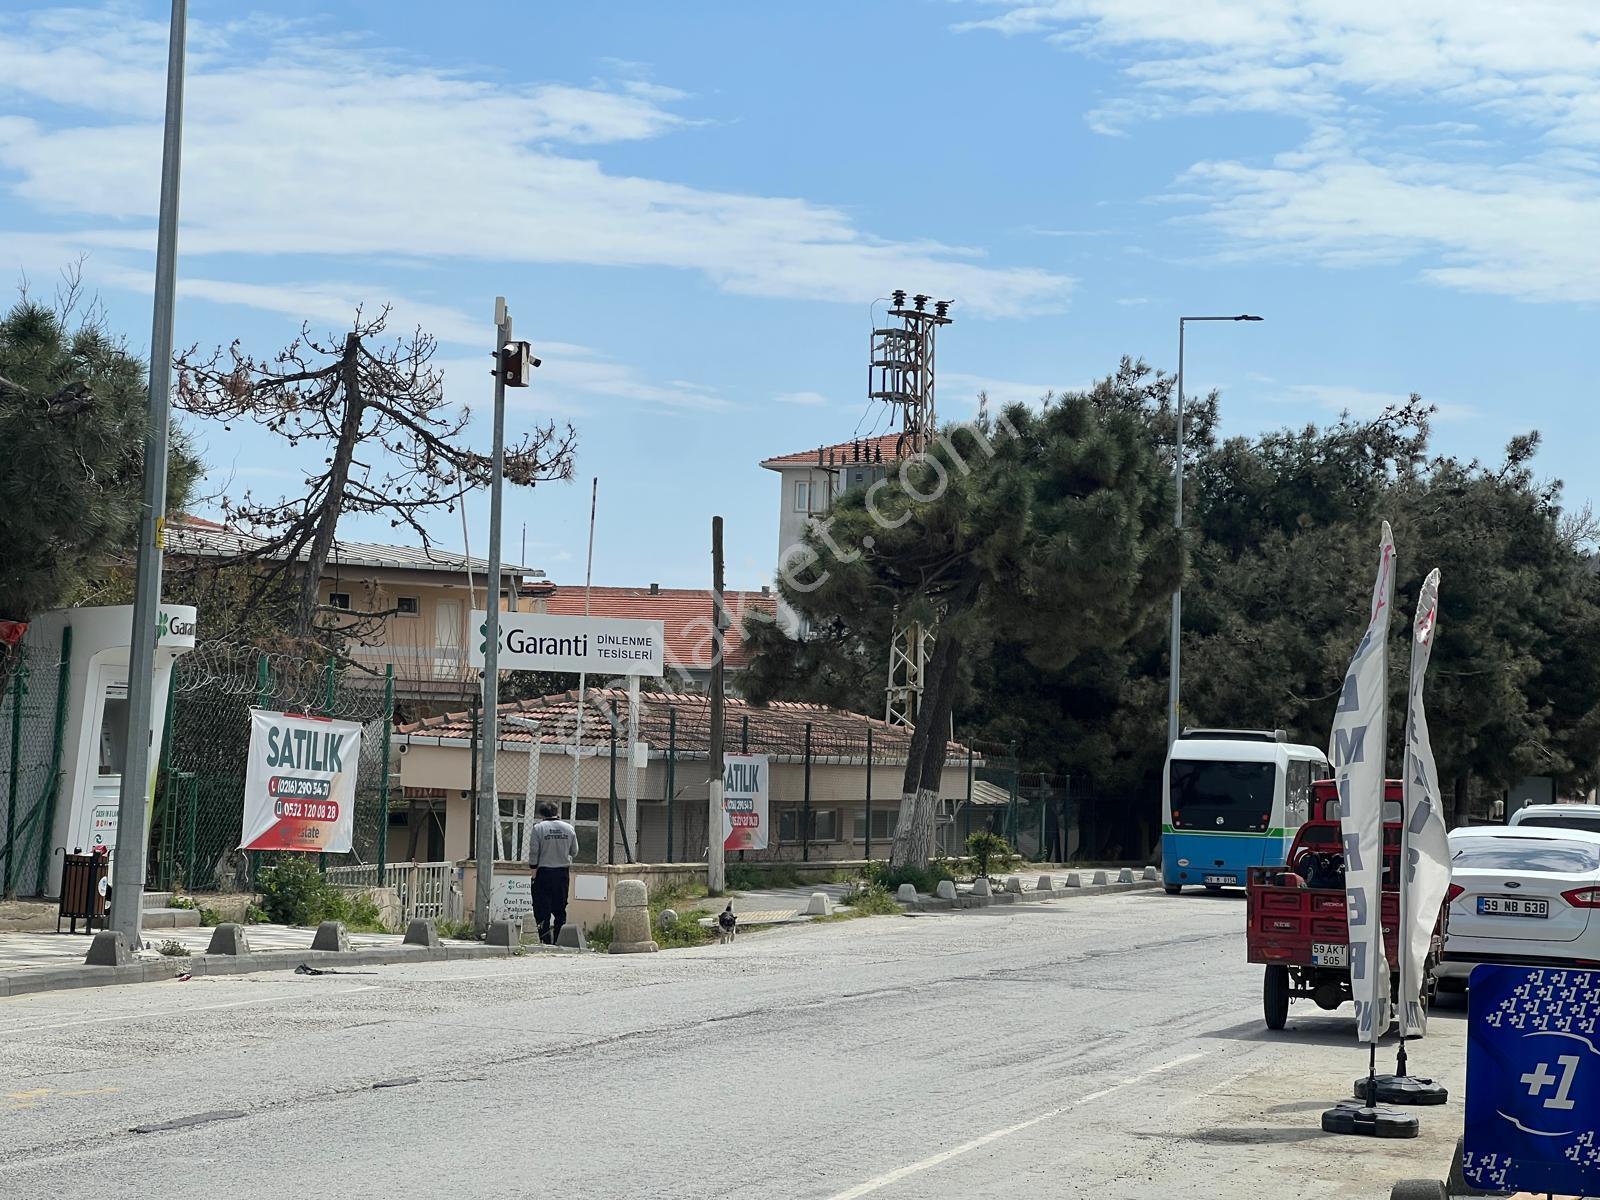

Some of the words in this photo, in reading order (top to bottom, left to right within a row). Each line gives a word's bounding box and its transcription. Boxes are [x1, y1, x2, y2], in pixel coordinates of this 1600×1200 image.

[170, 616, 195, 636] Gara
[506, 629, 588, 657] Garanti
[597, 633, 652, 647] DİNLENME
[597, 648, 652, 660] TESİSLERİ
[266, 726, 344, 773] SATILIK
[724, 763, 760, 792] ATILIK
[297, 781, 311, 795] 290
[284, 802, 302, 817] 0532
[304, 804, 316, 818] 120
[327, 805, 336, 819] 28
[515, 881, 531, 889] Gara
[1484, 900, 1498, 911] 59
[1504, 901, 1518, 912] NB
[1524, 902, 1546, 913] 638
[1313, 945, 1325, 954] 59
[1326, 945, 1346, 955] AKT
[1323, 956, 1340, 965] 505
[1520, 1055, 1580, 1110] +1
